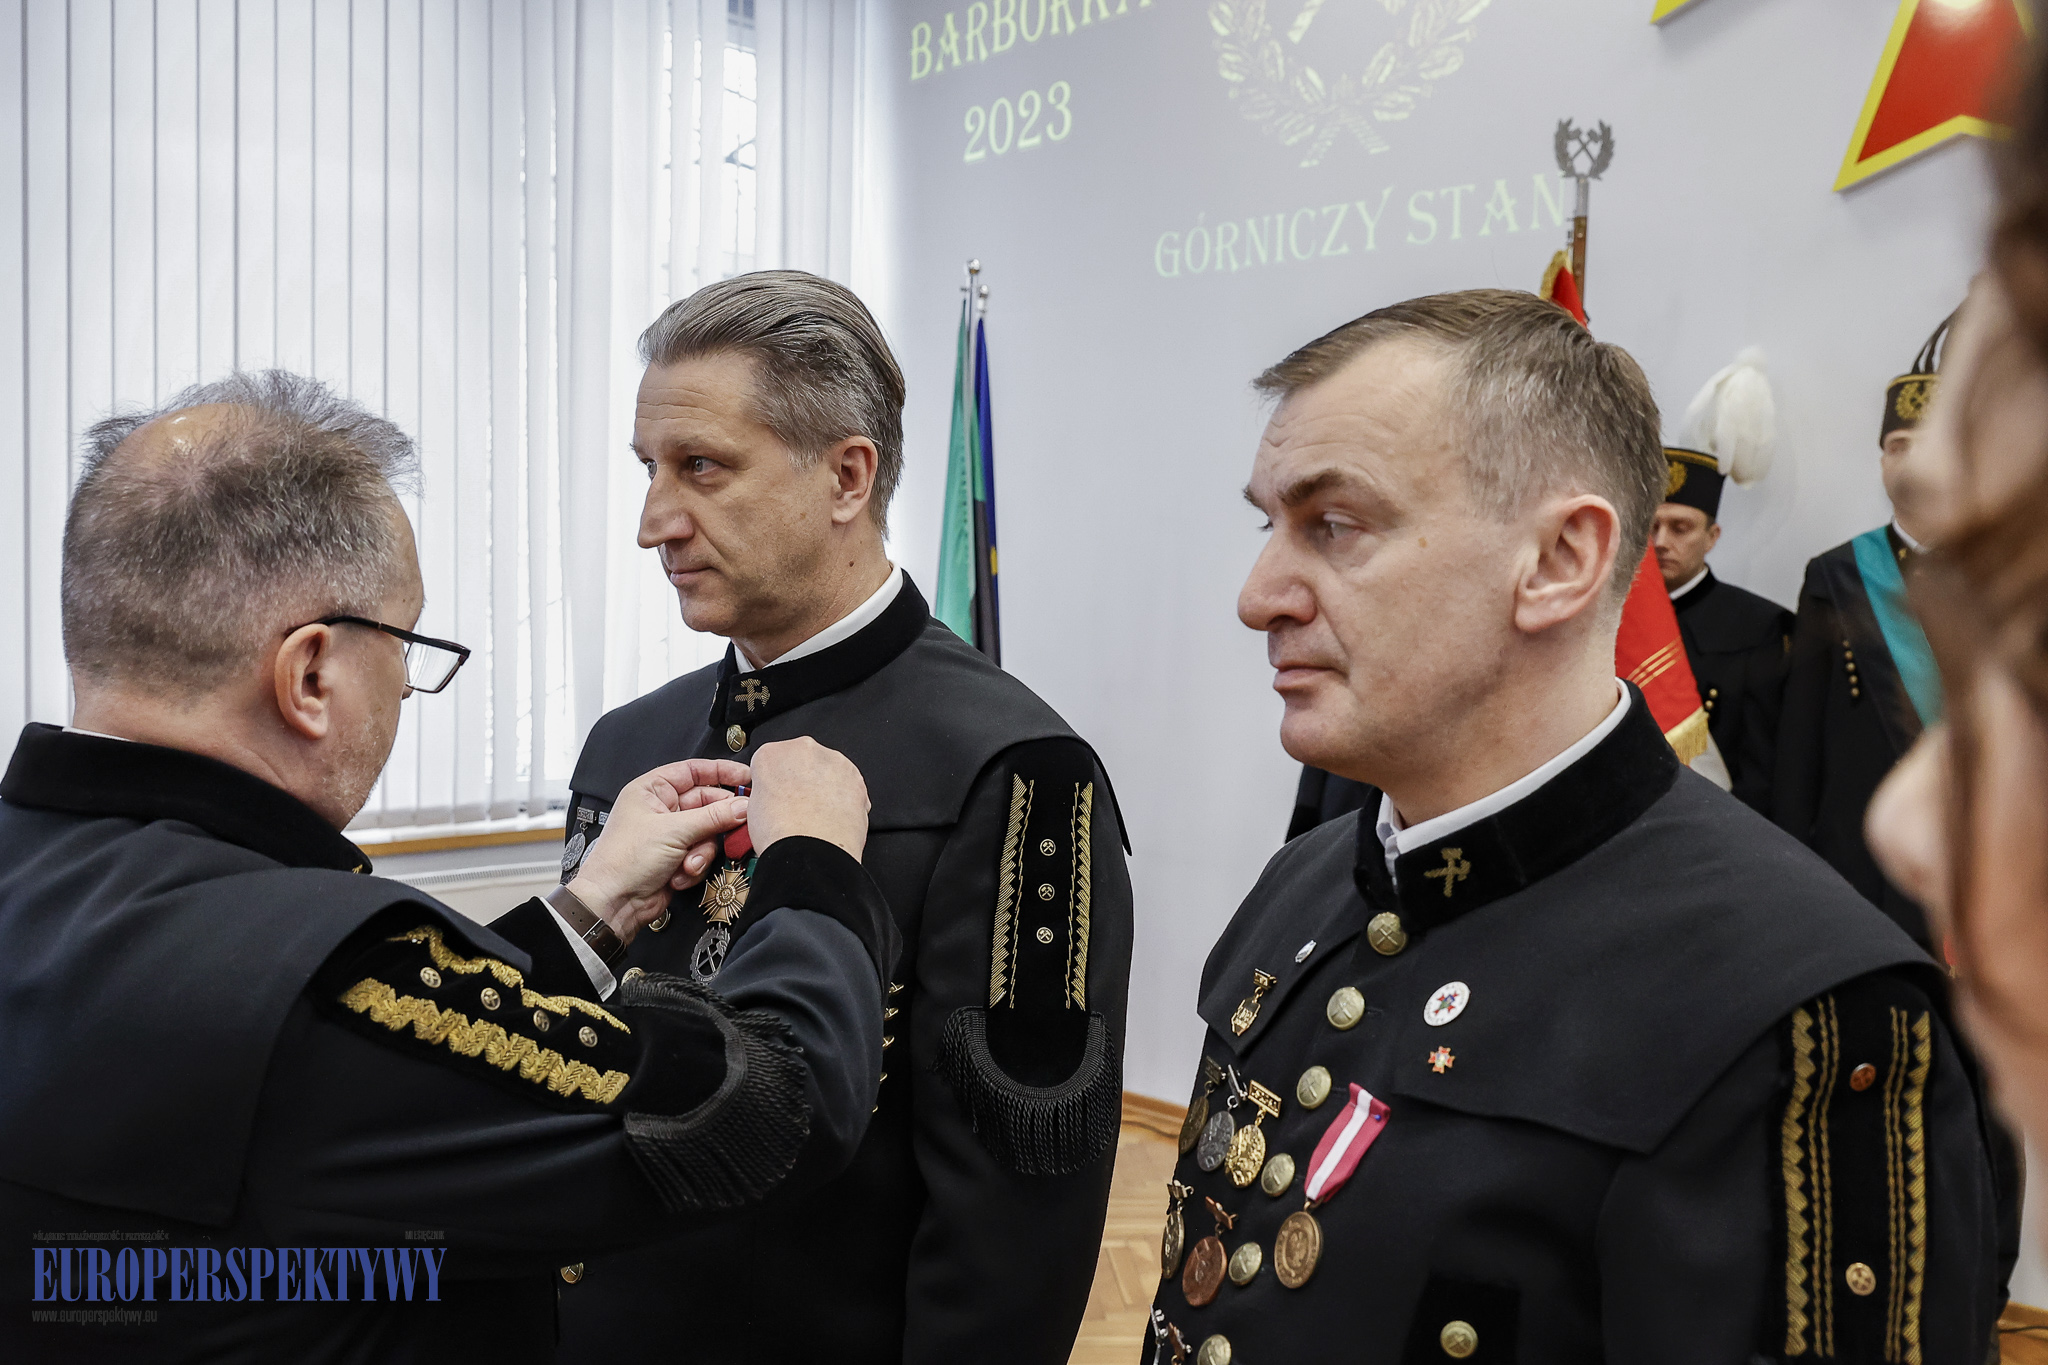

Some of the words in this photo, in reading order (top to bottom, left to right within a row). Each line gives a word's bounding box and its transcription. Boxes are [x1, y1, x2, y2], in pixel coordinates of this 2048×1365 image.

[963, 80, 1073, 163] 2023
[1154, 186, 1394, 278] GÓRNICZY
[1406, 168, 1565, 244] STAN
